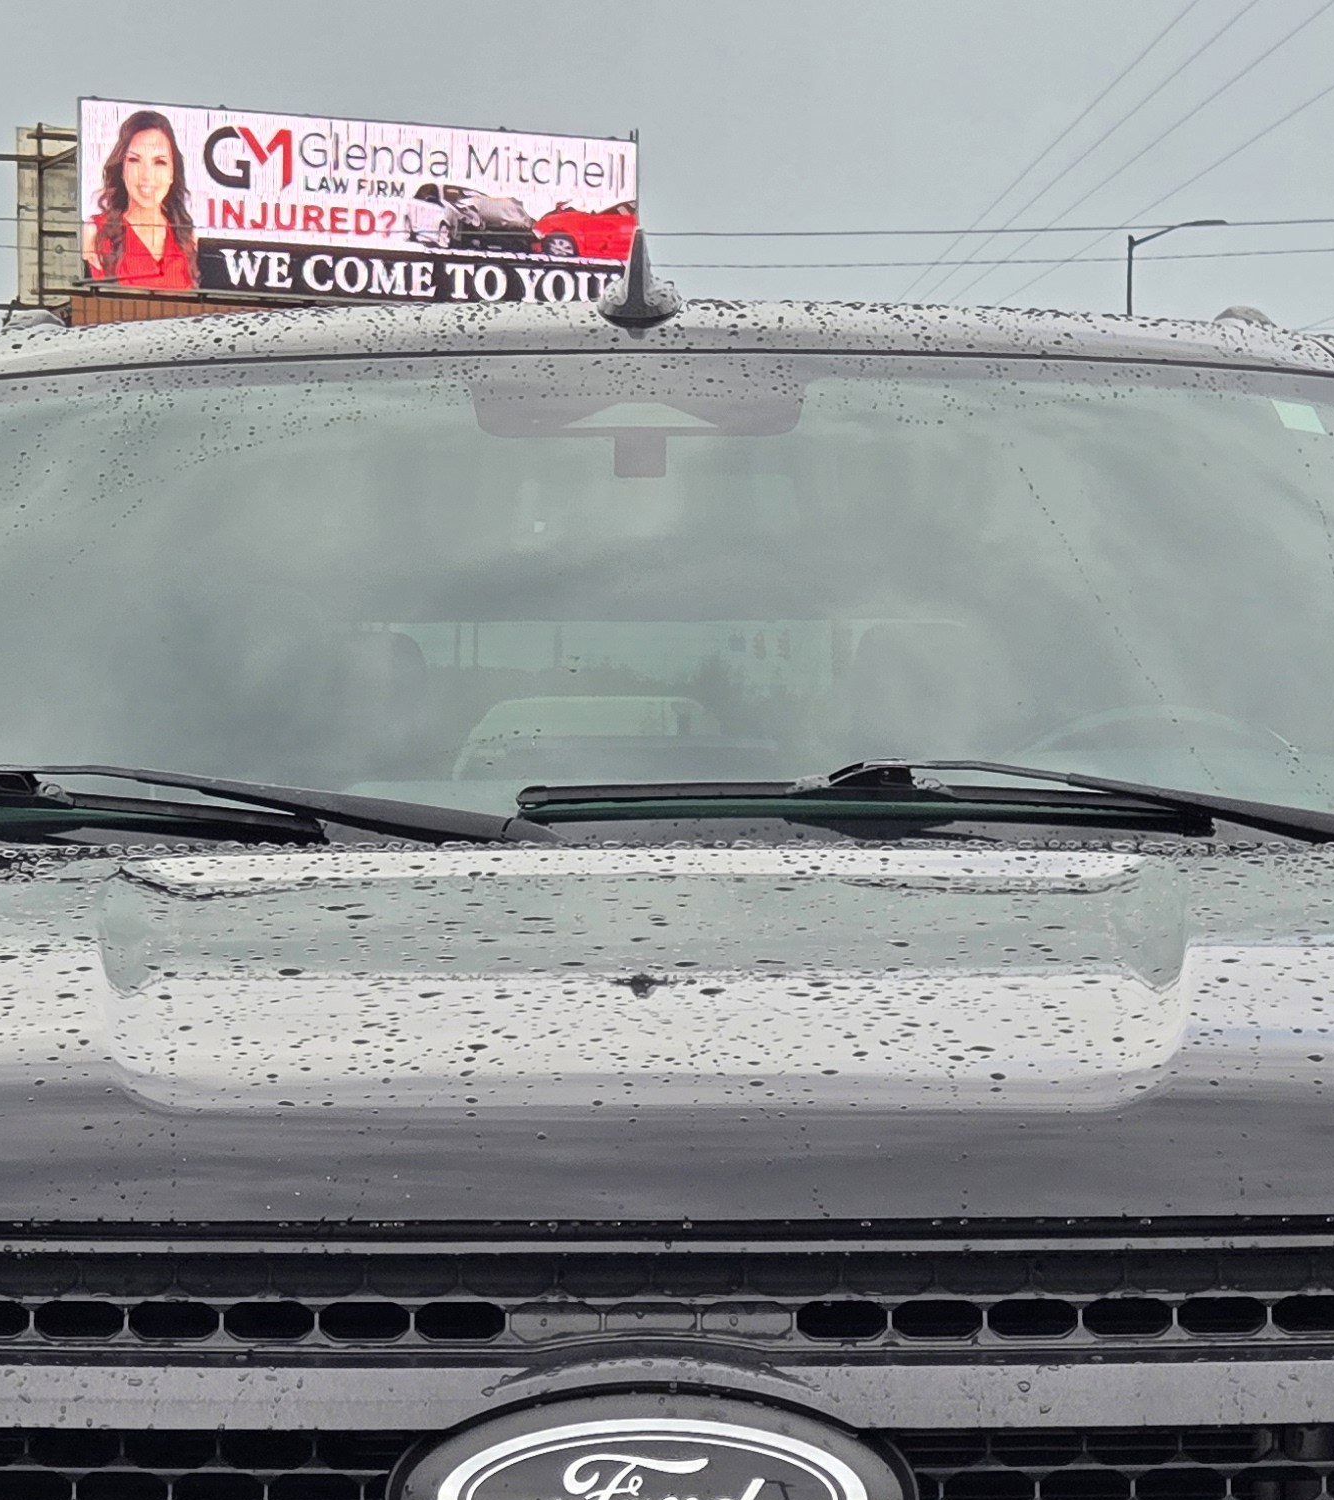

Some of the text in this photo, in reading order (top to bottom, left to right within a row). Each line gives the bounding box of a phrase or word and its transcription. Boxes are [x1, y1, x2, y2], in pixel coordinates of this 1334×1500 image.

[204, 126, 293, 190] GM
[299, 132, 625, 189] Glenda Mitchell
[305, 176, 406, 198] LAW FIRM
[208, 198, 397, 237] INJURED?
[219, 249, 293, 288] WE
[302, 254, 437, 298] COME
[446, 263, 508, 301] TO
